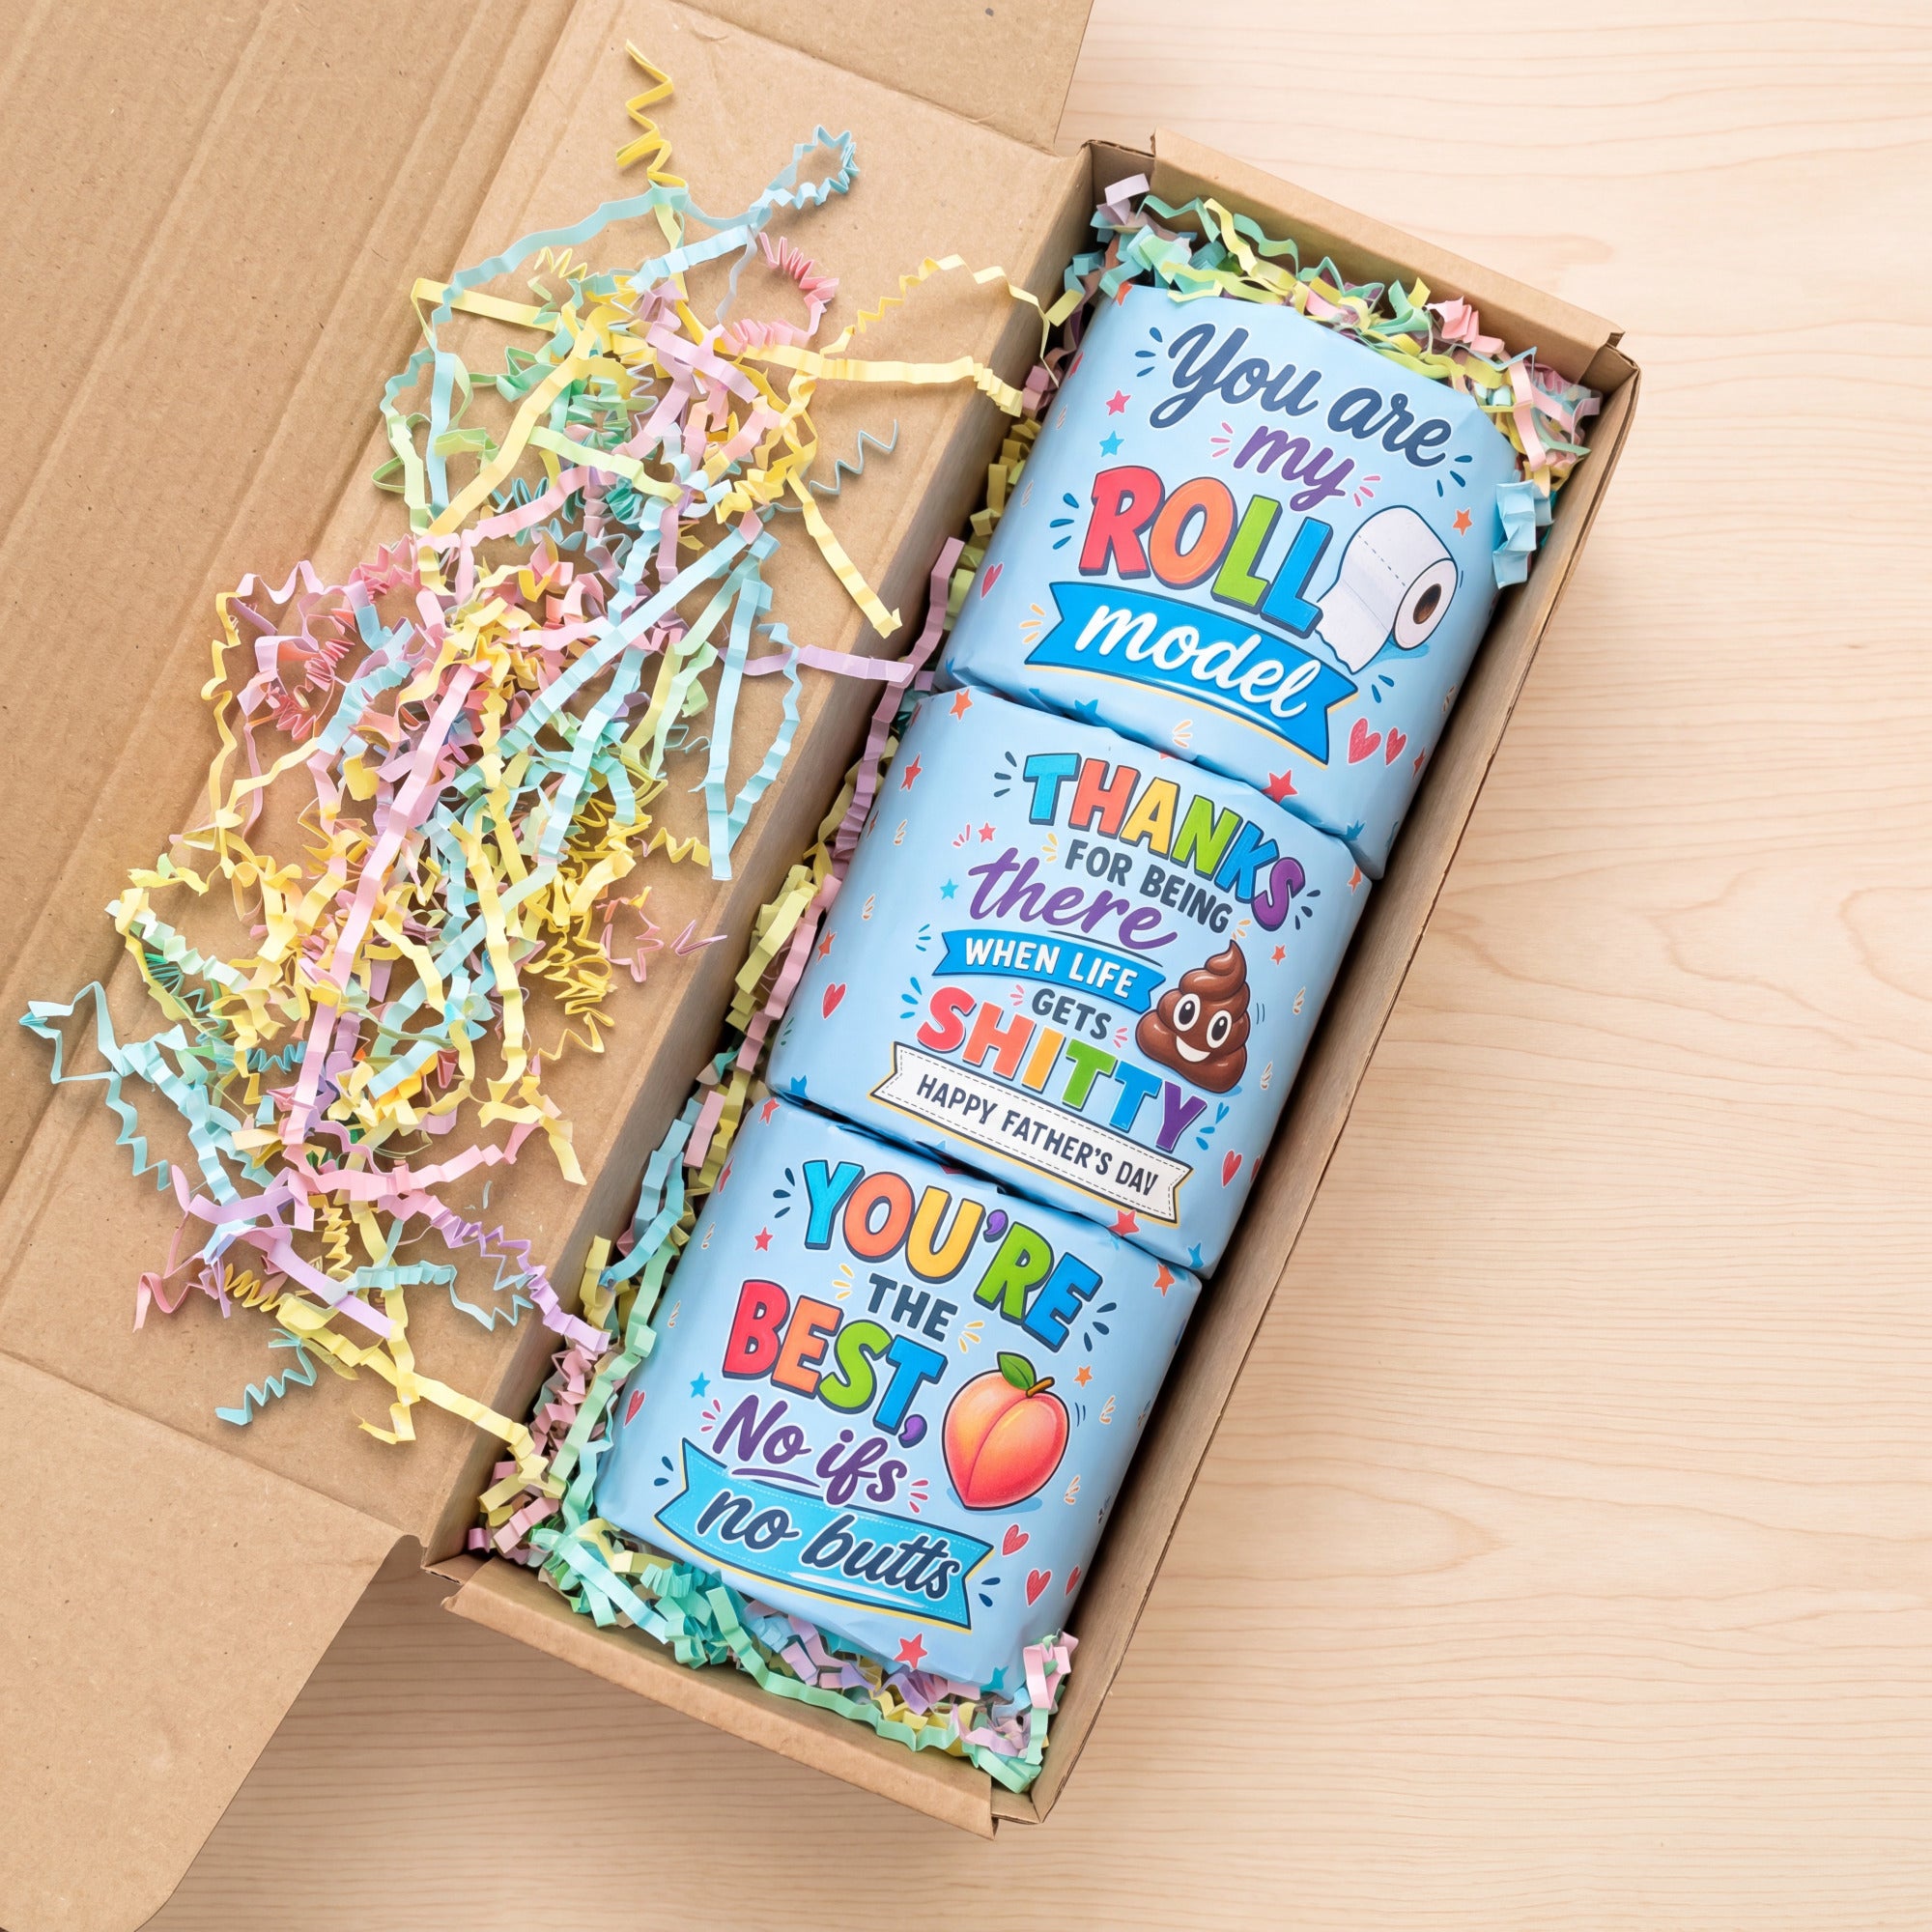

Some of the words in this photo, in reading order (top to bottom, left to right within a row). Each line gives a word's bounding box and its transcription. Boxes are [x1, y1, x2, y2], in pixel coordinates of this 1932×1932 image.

[1150, 323, 1324, 429] You
[1328, 387, 1452, 467] are
[1233, 425, 1355, 512] my
[1078, 466, 1333, 639] ROLL
[1075, 604, 1321, 719] model
[1023, 753, 1305, 931] THANKS
[1065, 840, 1133, 887] FOR
[1140, 867, 1233, 934] BEING
[968, 847, 1178, 950] there
[965, 937, 1059, 976] WHEN
[1067, 952, 1139, 999] LIFE
[1032, 988, 1112, 1040] GETS
[916, 986, 1208, 1153] SHITTY
[917, 1074, 997, 1125] HAPPY
[1001, 1107, 1114, 1176] FATHER'S
[803, 1159, 1102, 1352] YOU'RE
[868, 1273, 958, 1342] THE
[722, 1279, 948, 1448] BEST,
[712, 1394, 811, 1466] No
[816, 1429, 907, 1506] ifs
[696, 1490, 799, 1549] no
[801, 1515, 960, 1599] butts
